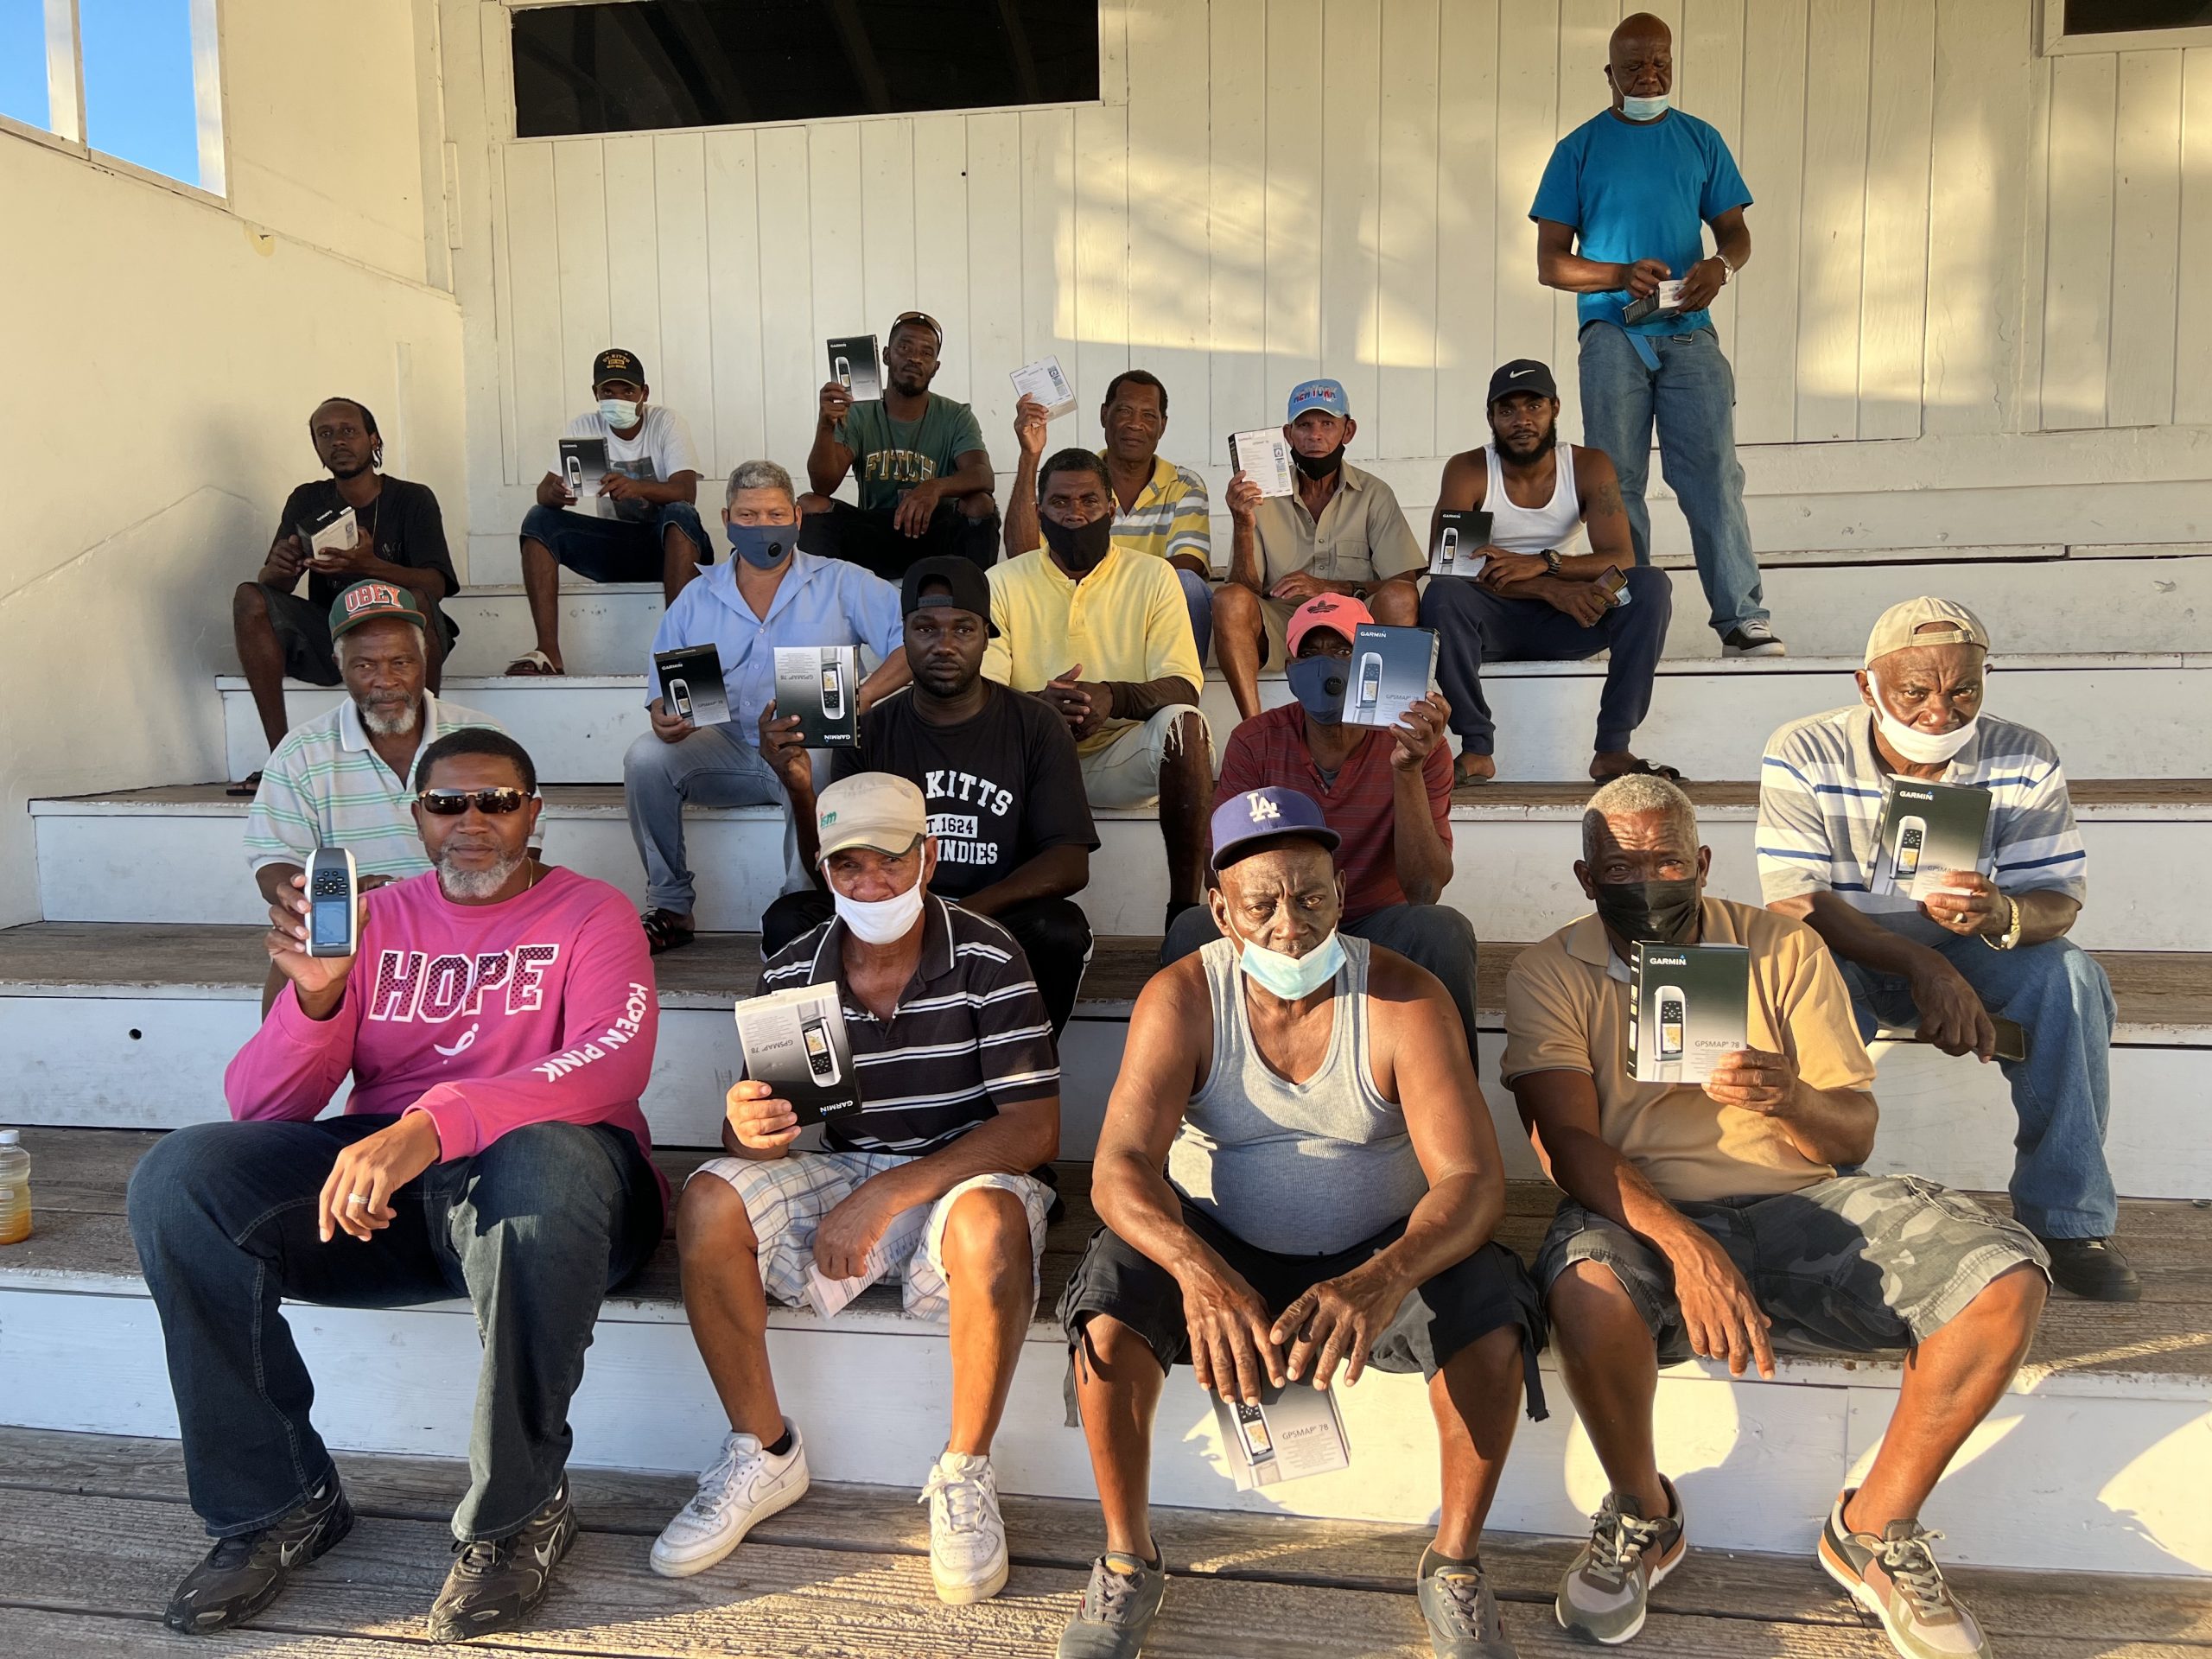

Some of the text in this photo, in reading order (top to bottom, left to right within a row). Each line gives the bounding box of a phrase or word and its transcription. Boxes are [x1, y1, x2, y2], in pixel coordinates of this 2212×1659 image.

[865, 448, 937, 481] FITCH
[345, 583, 402, 612] OBEY
[925, 770, 1014, 817] KITTS
[1899, 790, 1934, 801] GARMIN
[1247, 792, 1281, 823] LA
[926, 817, 974, 835] T.1624
[937, 839, 998, 865] INDIES
[1649, 957, 1687, 966] GARMIN
[368, 943, 560, 1023] HOPE
[531, 1043, 606, 1083] PINK
[751, 1046, 760, 1054] 78
[820, 1100, 854, 1113] GARMIN
[1319, 1423, 1329, 1432] 78
